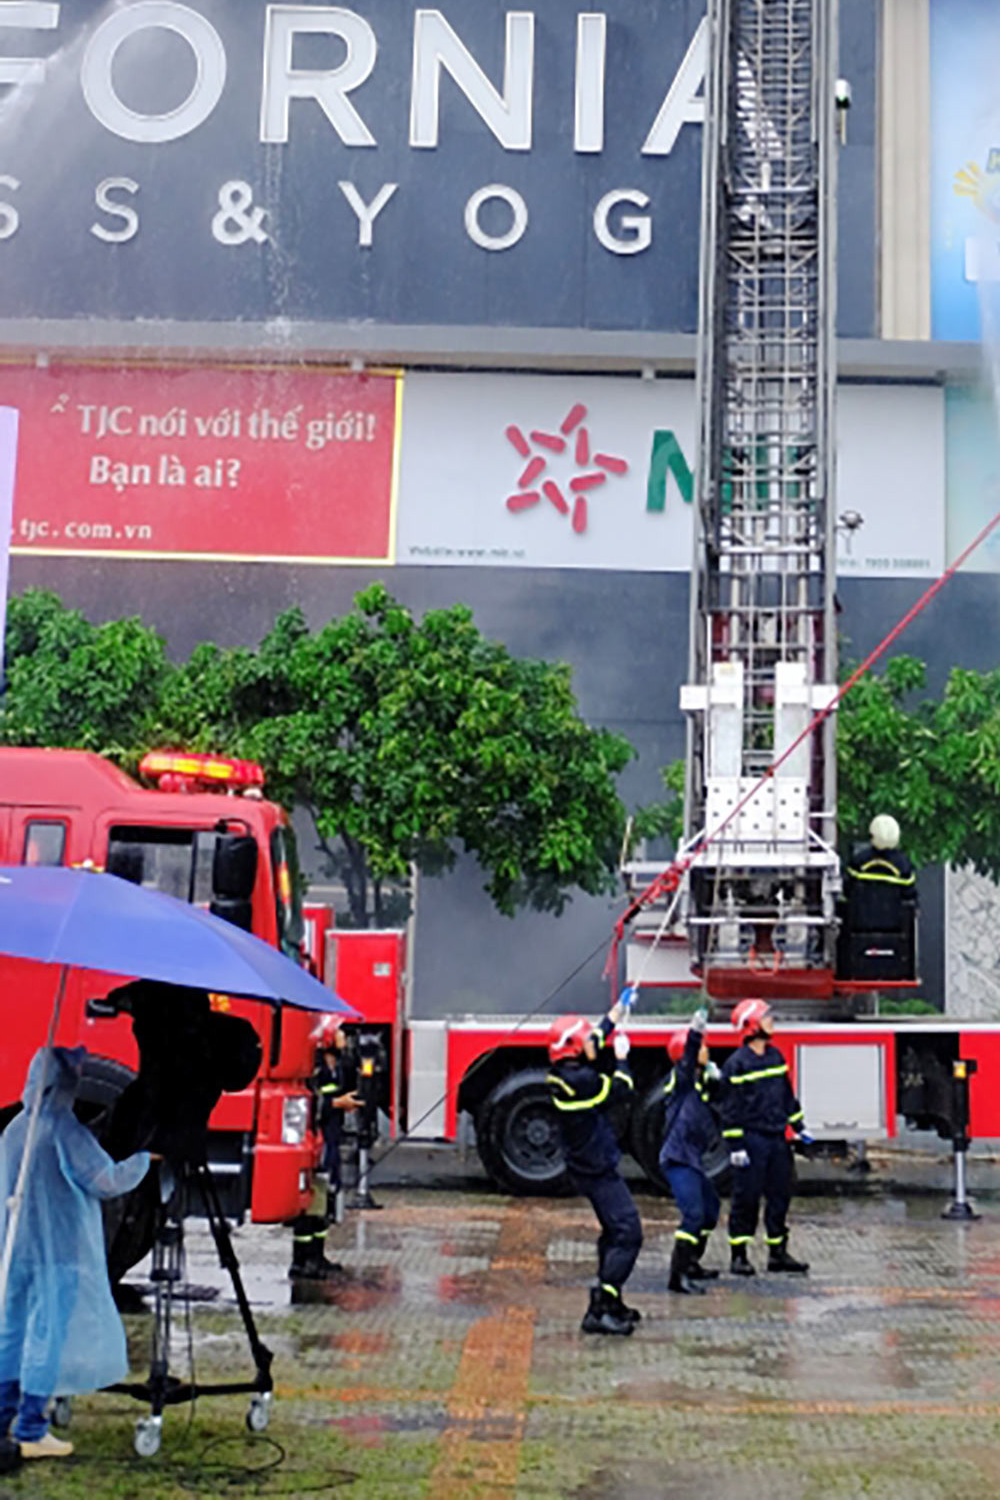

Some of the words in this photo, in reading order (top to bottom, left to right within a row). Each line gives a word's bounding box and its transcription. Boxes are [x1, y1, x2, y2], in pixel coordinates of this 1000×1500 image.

[211, 180, 268, 246] &
[77, 404, 133, 438] TJC
[138, 406, 188, 437] nói
[194, 407, 241, 438] với
[247, 403, 304, 441] thế
[305, 411, 377, 451] giới!
[89, 455, 151, 493] Bạn
[157, 454, 186, 486] là
[193, 458, 242, 488] ai?
